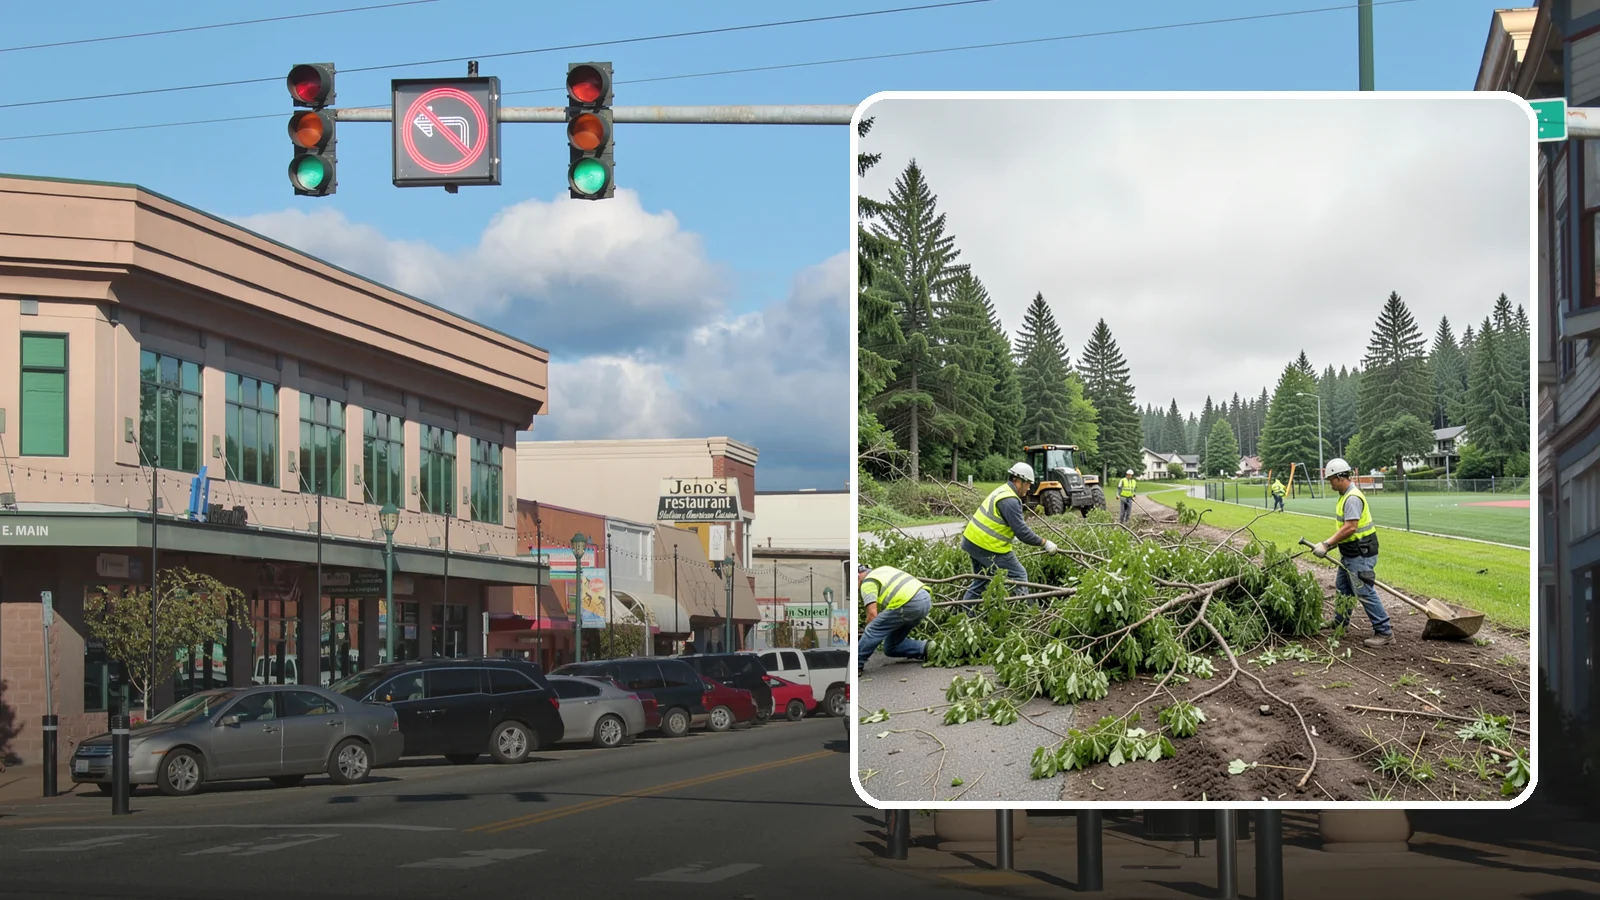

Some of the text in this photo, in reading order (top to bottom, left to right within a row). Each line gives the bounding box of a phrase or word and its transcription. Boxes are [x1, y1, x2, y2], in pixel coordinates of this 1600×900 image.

[670, 480, 727, 495] Jeno's
[665, 496, 731, 509] restaurant
[659, 510, 681, 520] Italian
[686, 510, 714, 519] American
[715, 509, 737, 519] Cuisine
[2, 525, 49, 536] E. MAIN
[797, 608, 828, 616] Street
